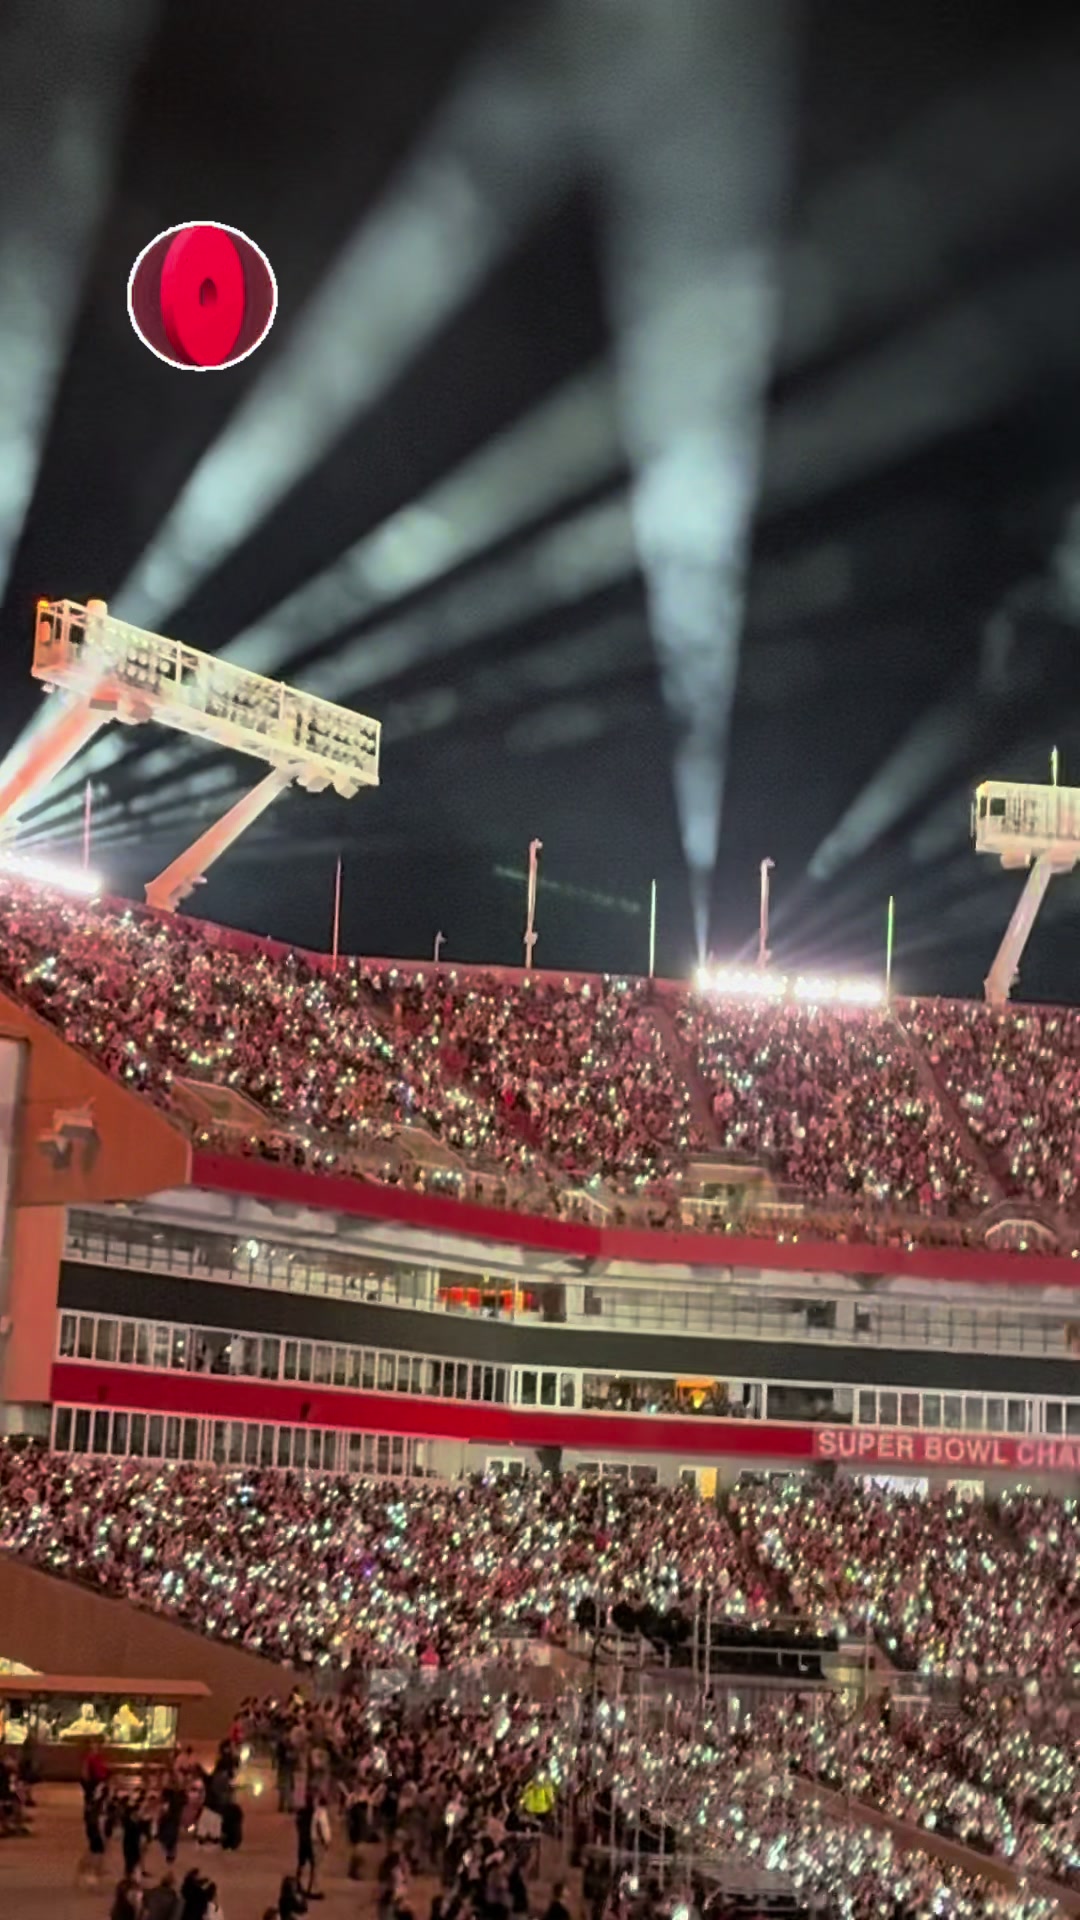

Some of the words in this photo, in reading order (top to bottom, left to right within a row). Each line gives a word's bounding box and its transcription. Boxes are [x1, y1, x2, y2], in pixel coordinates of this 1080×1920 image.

[818, 1429, 914, 1459] SUPER
[923, 1437, 1009, 1464] BOWL
[1016, 1441, 1080, 1467] CHA
